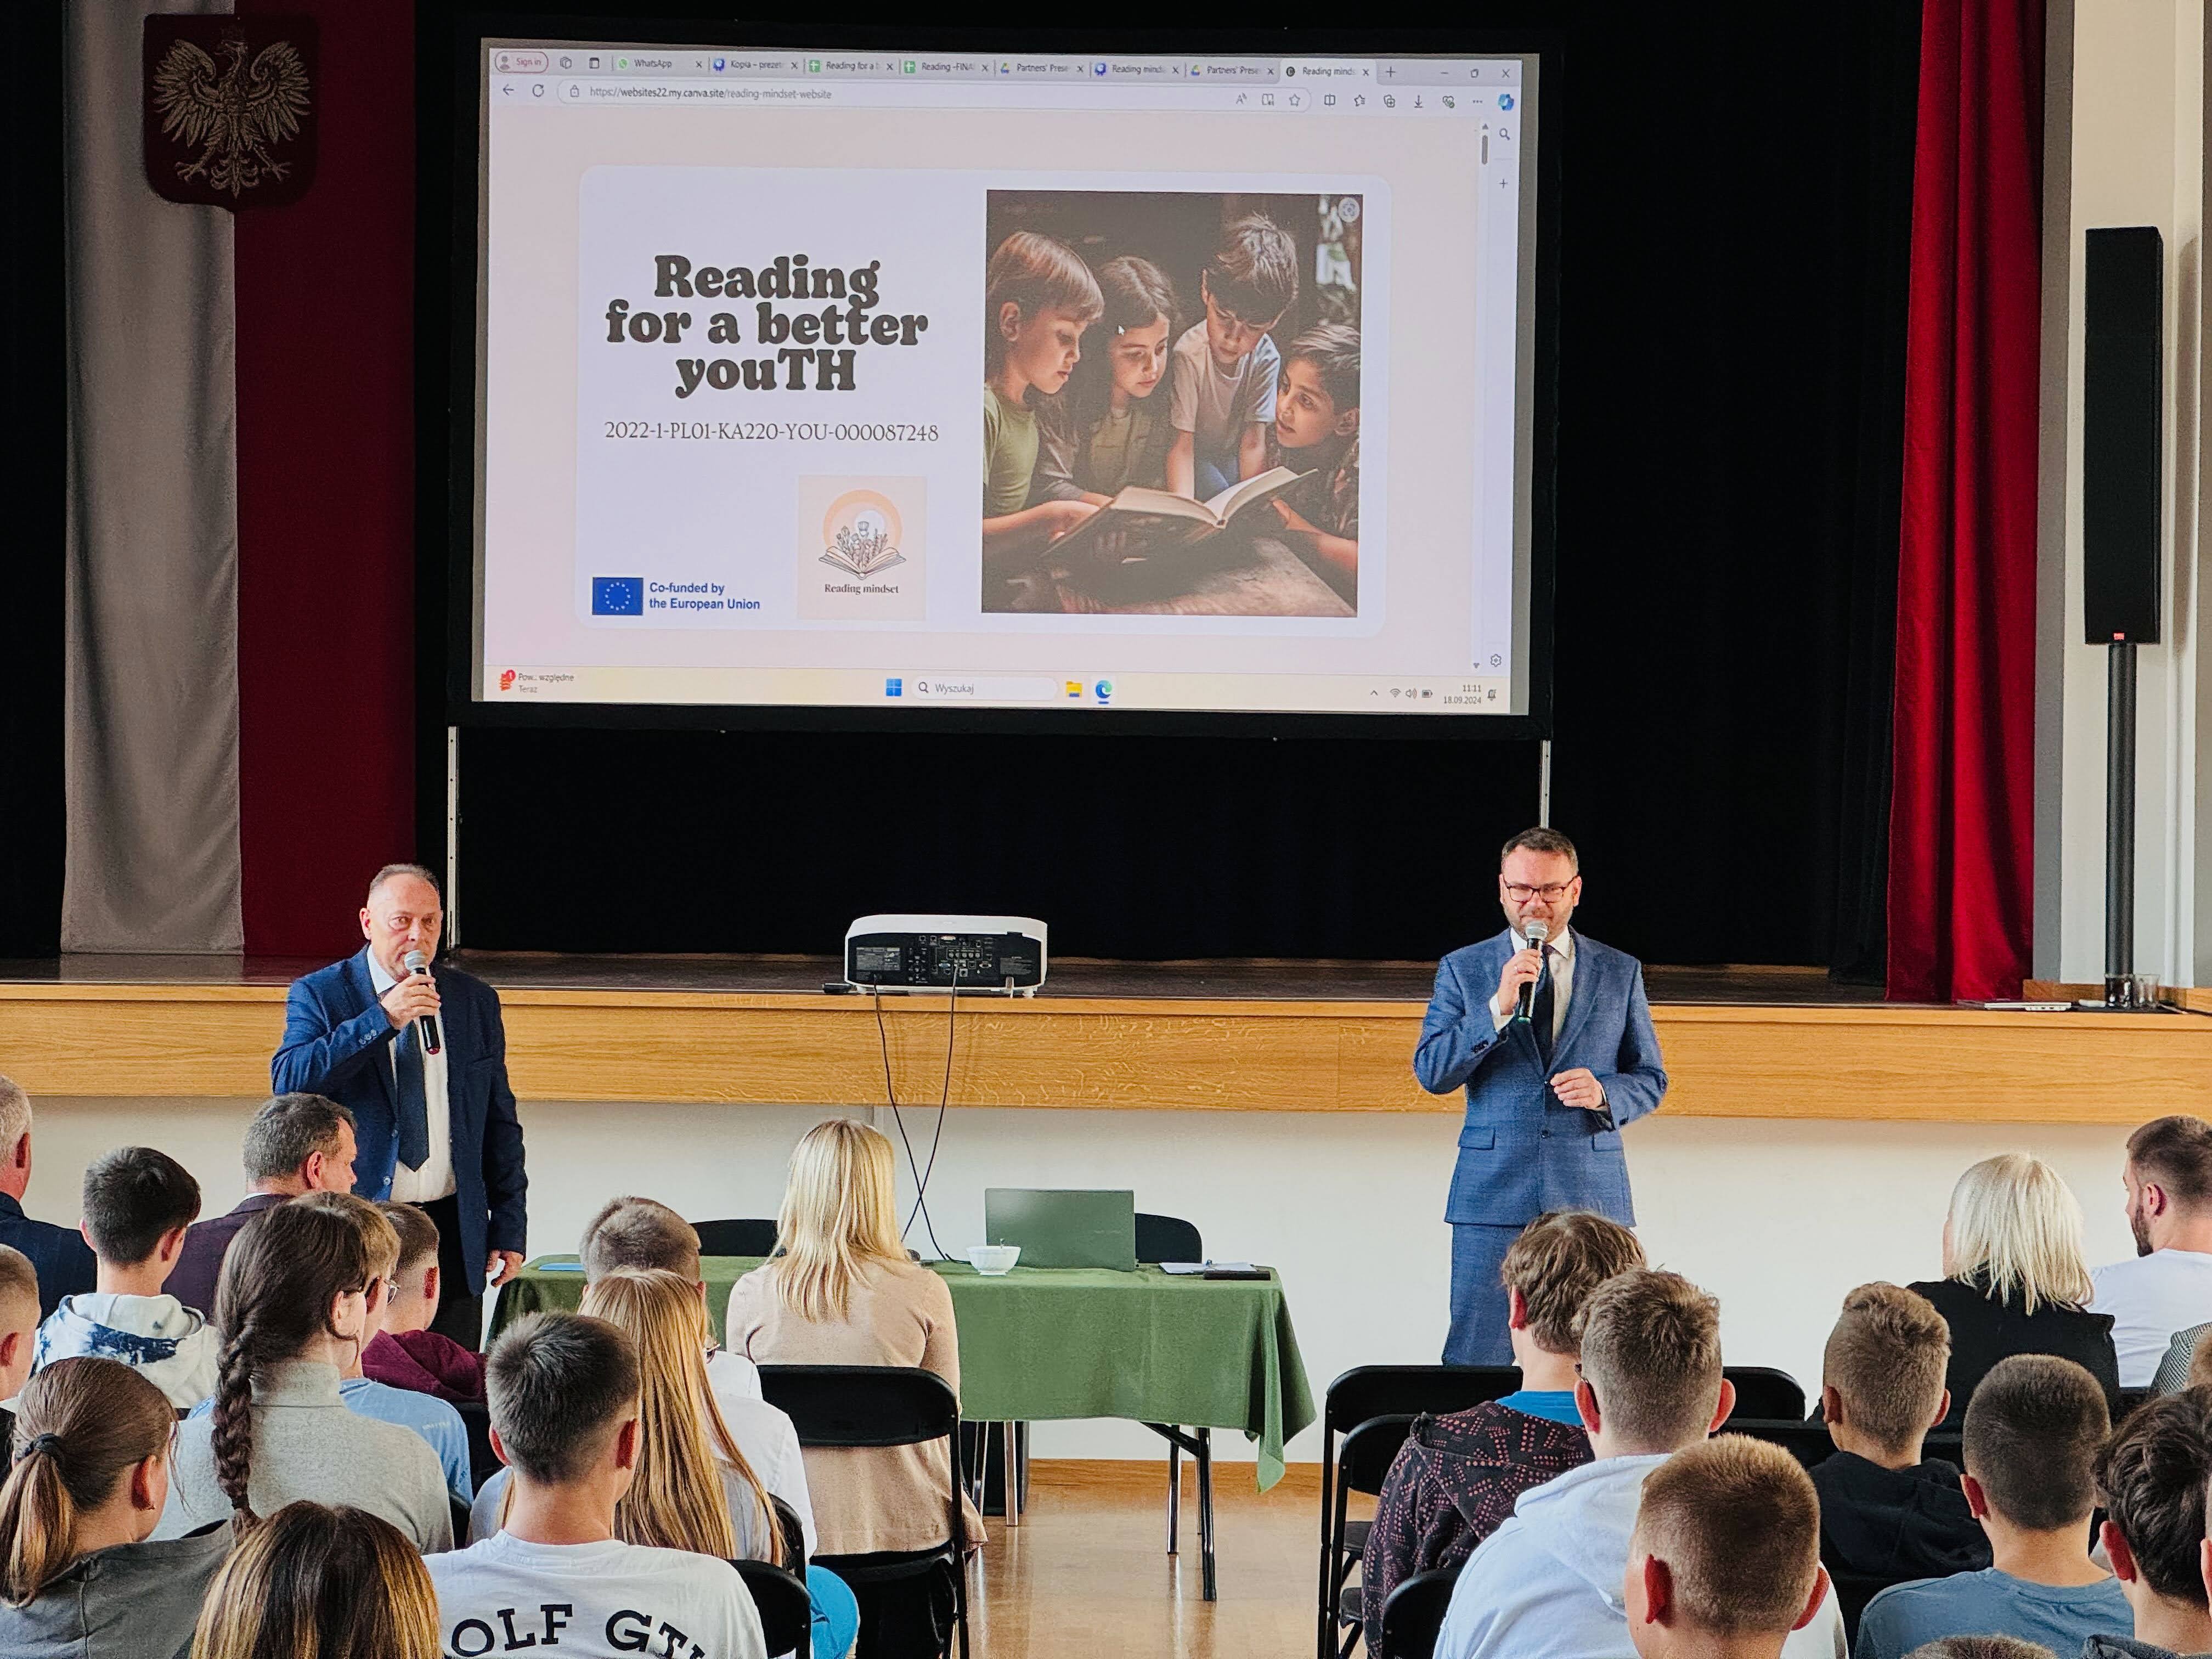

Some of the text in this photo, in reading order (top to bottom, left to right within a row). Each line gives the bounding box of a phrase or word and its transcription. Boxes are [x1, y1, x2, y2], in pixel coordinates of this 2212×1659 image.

[517, 58, 541, 67] Sign in
[634, 59, 672, 69] WhatsApp
[826, 61, 856, 71] Reading
[857, 61, 868, 70] for
[922, 62, 951, 72] Reading
[1112, 64, 1142, 75] Reading
[1302, 66, 1332, 77] Reading
[653, 253, 881, 309] Reading
[605, 298, 929, 346] for a better
[675, 347, 857, 399] youTH
[604, 420, 939, 442] 2022-1-PL01-KA220-YOU-000087248
[650, 582, 725, 596] Co-funded by
[825, 583, 899, 595] Reading mindset
[649, 598, 760, 612] the European Union
[518, 684, 538, 693] Teraz
[935, 683, 974, 695] Wyszukaj
[1443, 696, 1482, 704] 18.09.2024
[444, 1604, 573, 1658] OLF
